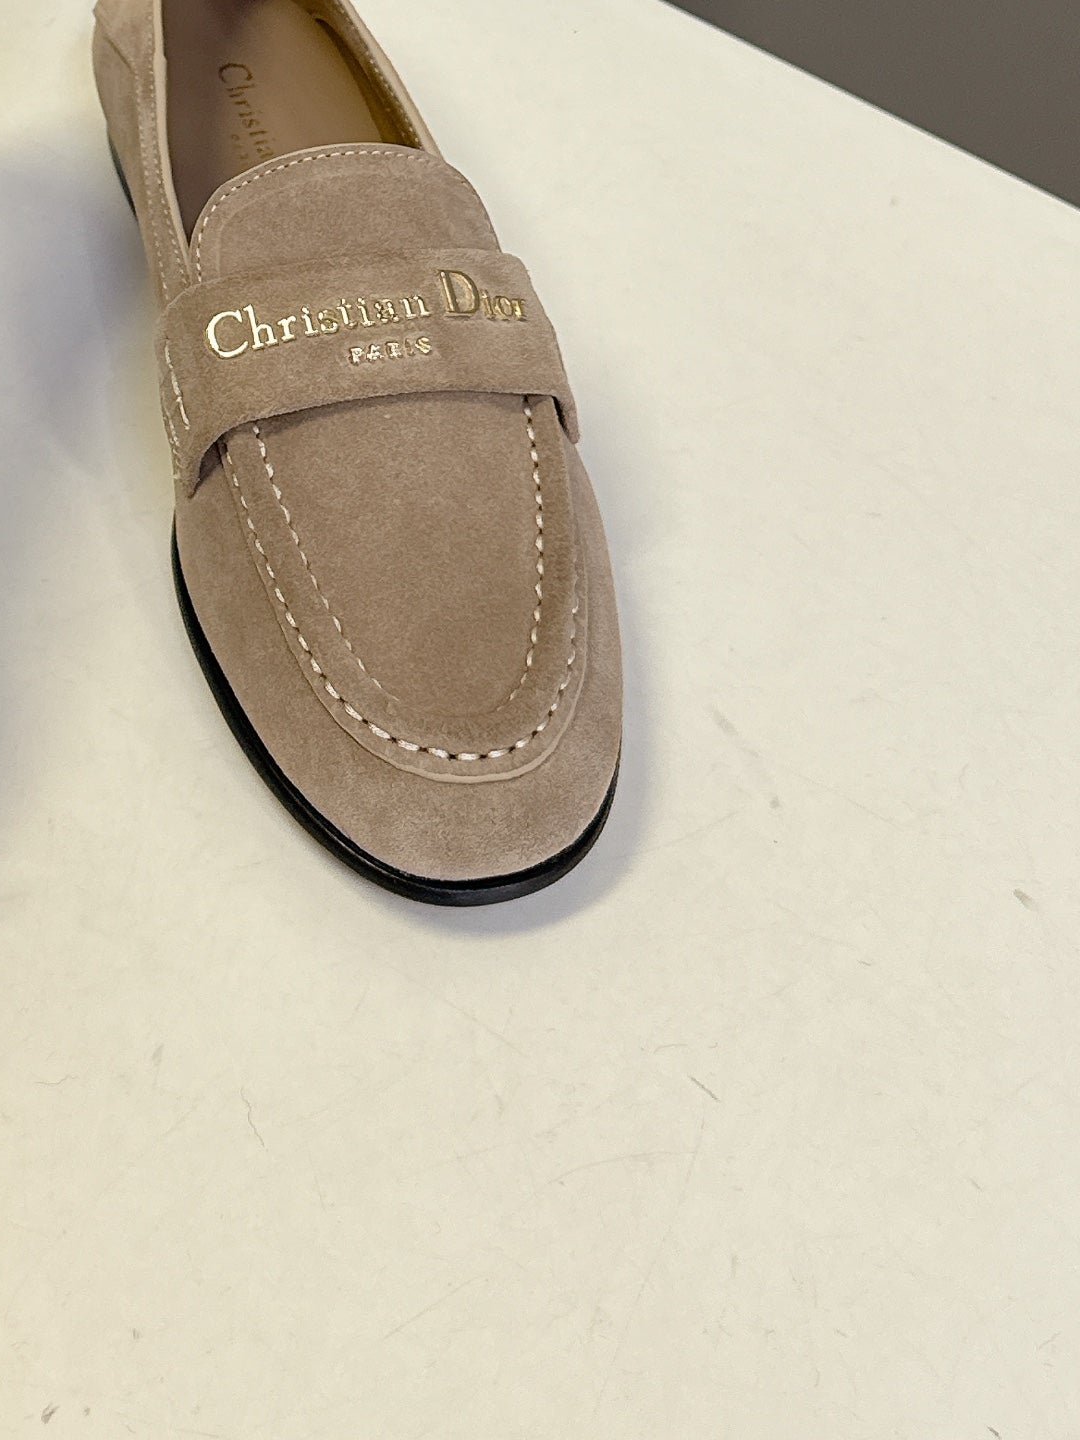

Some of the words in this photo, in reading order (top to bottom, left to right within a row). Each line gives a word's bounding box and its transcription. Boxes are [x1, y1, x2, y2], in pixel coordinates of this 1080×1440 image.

[219, 63, 275, 159] Christia
[205, 294, 432, 359] Christian
[437, 269, 528, 322] Dior
[347, 336, 433, 365] PARIS
